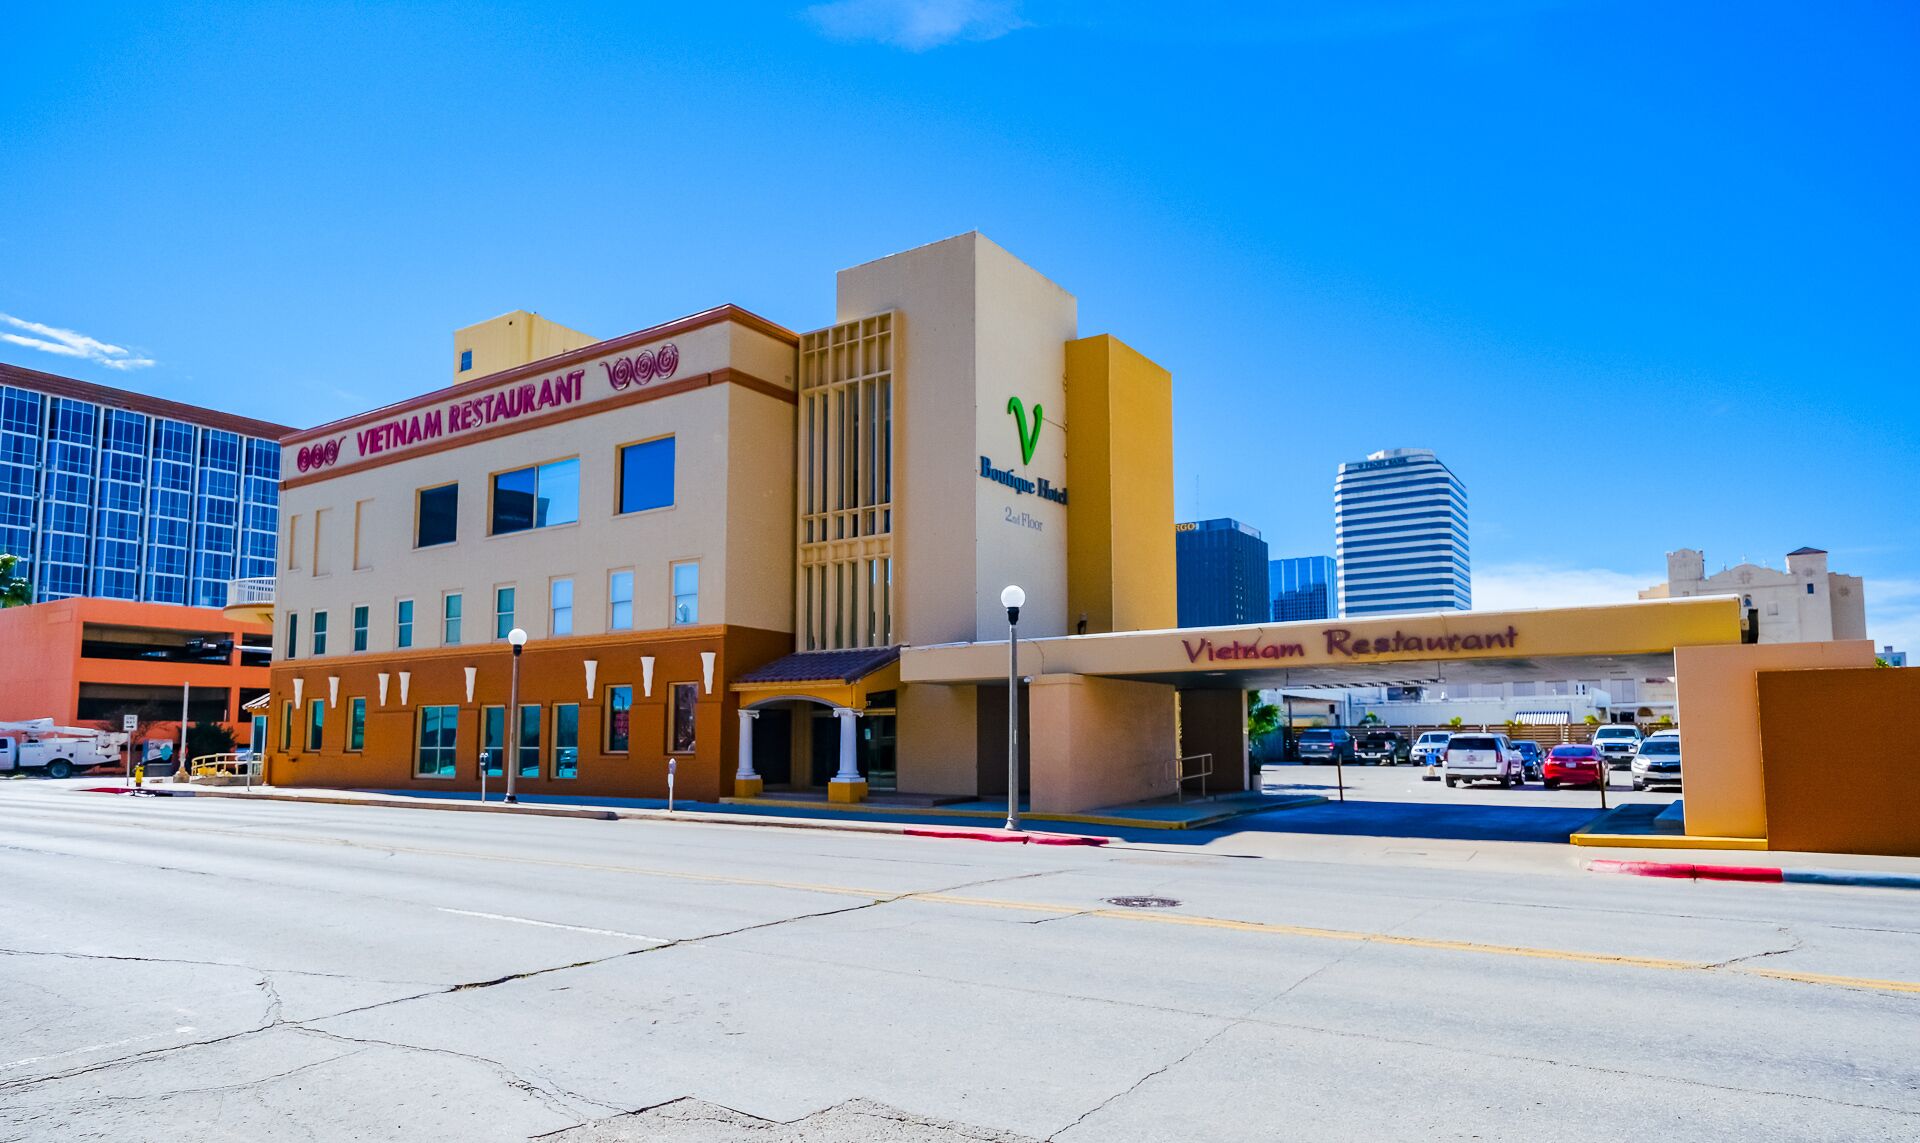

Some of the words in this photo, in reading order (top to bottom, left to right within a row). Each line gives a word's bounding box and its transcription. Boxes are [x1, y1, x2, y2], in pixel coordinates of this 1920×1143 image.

[357, 409, 442, 456] VIETNAM
[449, 370, 585, 433] RESTAURANT
[1007, 396, 1043, 466] V
[980, 455, 1035, 495] Boutique
[1037, 477, 1069, 506] Hotel
[1005, 506, 1020, 526] 2nd
[1021, 513, 1043, 532] Floor
[1182, 636, 1304, 664] Vietnam
[1322, 626, 1519, 657] Restaurant
